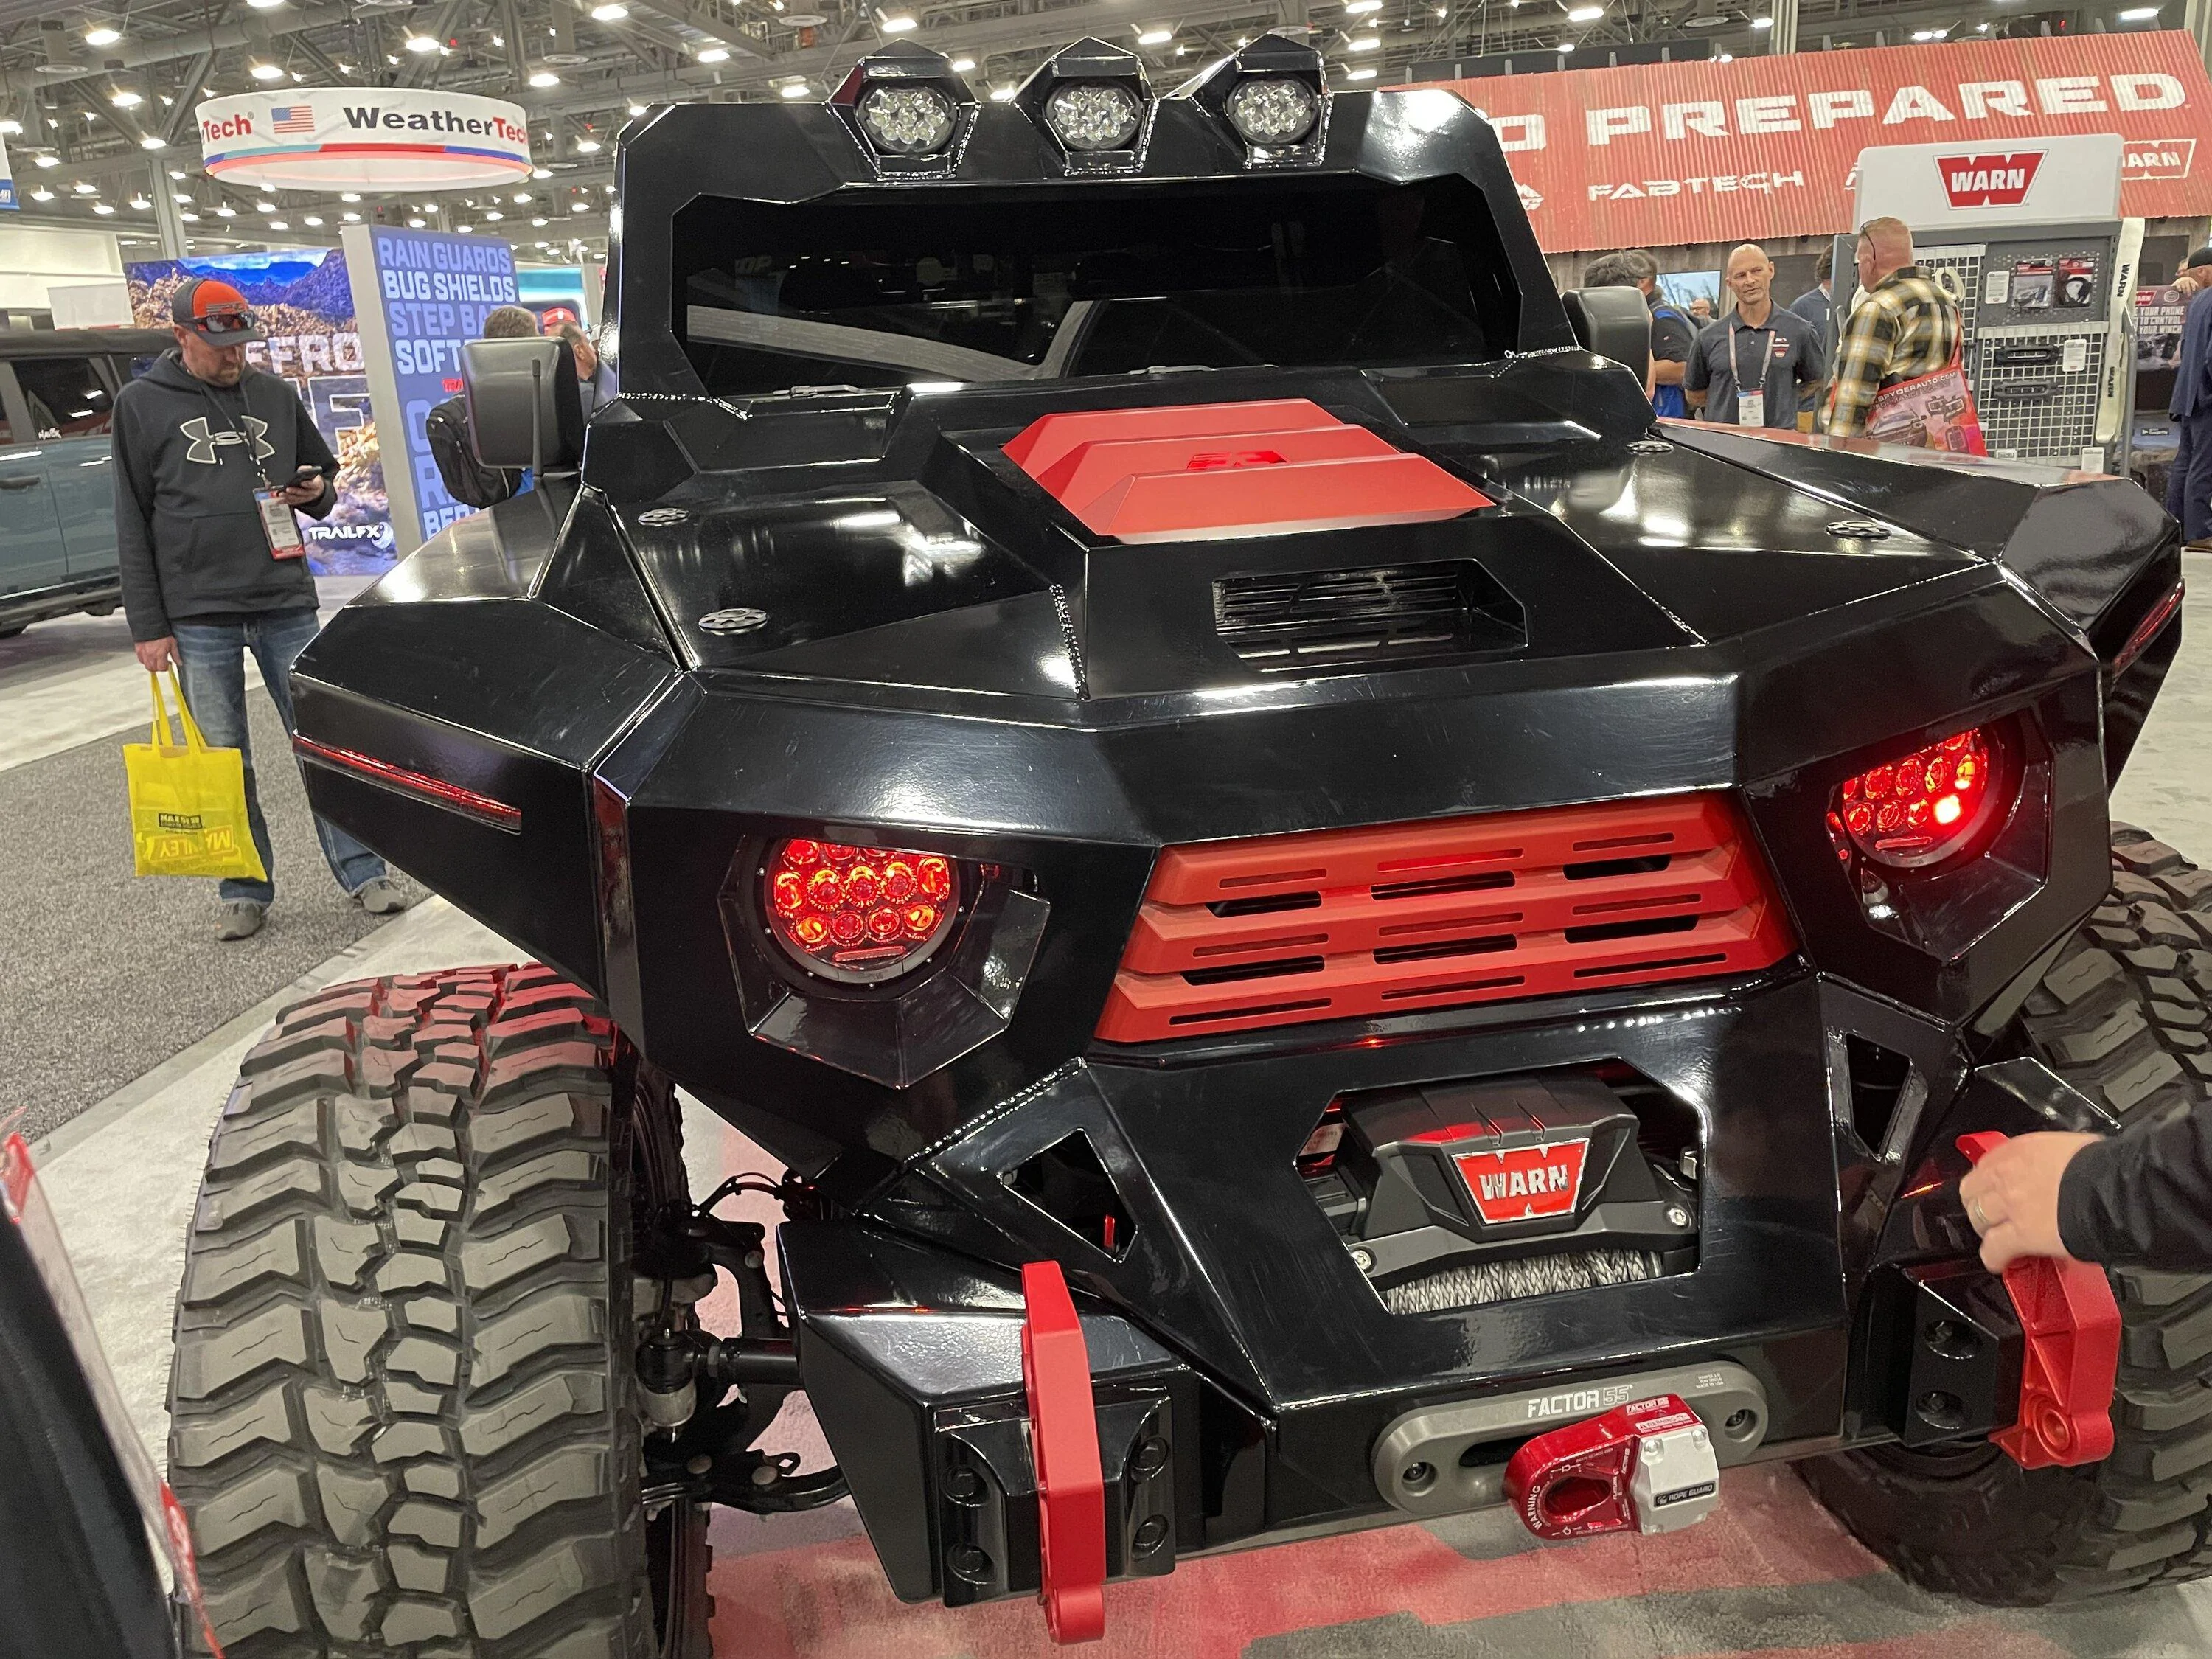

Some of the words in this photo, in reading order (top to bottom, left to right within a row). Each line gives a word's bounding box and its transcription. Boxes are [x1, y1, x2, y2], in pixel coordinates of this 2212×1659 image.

[343, 107, 528, 143] WeatherTec
[1585, 73, 2186, 146] PREPARED
[2122, 150, 2181, 169] ARN
[1588, 170, 1804, 201] FABTECH
[1951, 168, 2025, 193] WARN
[377, 237, 431, 269] RAIN
[432, 242, 512, 274] GUARDS
[382, 269, 431, 301] BUG
[433, 272, 515, 302] SHIELDS
[2117, 263, 2131, 297] WARN
[389, 302, 456, 336] STEP
[2161, 305, 2185, 315] PHONE
[395, 339, 462, 375] SOFT
[308, 524, 380, 540] TRAILFX
[1478, 1164, 1569, 1201] WARN
[1528, 1390, 1599, 1418] FACTOR
[1603, 1385, 1630, 1406] 55
[1527, 1485, 1542, 1531] WARNING
[1669, 1490, 1688, 1501] ROPE
[1688, 1484, 1713, 1496] GUARD
